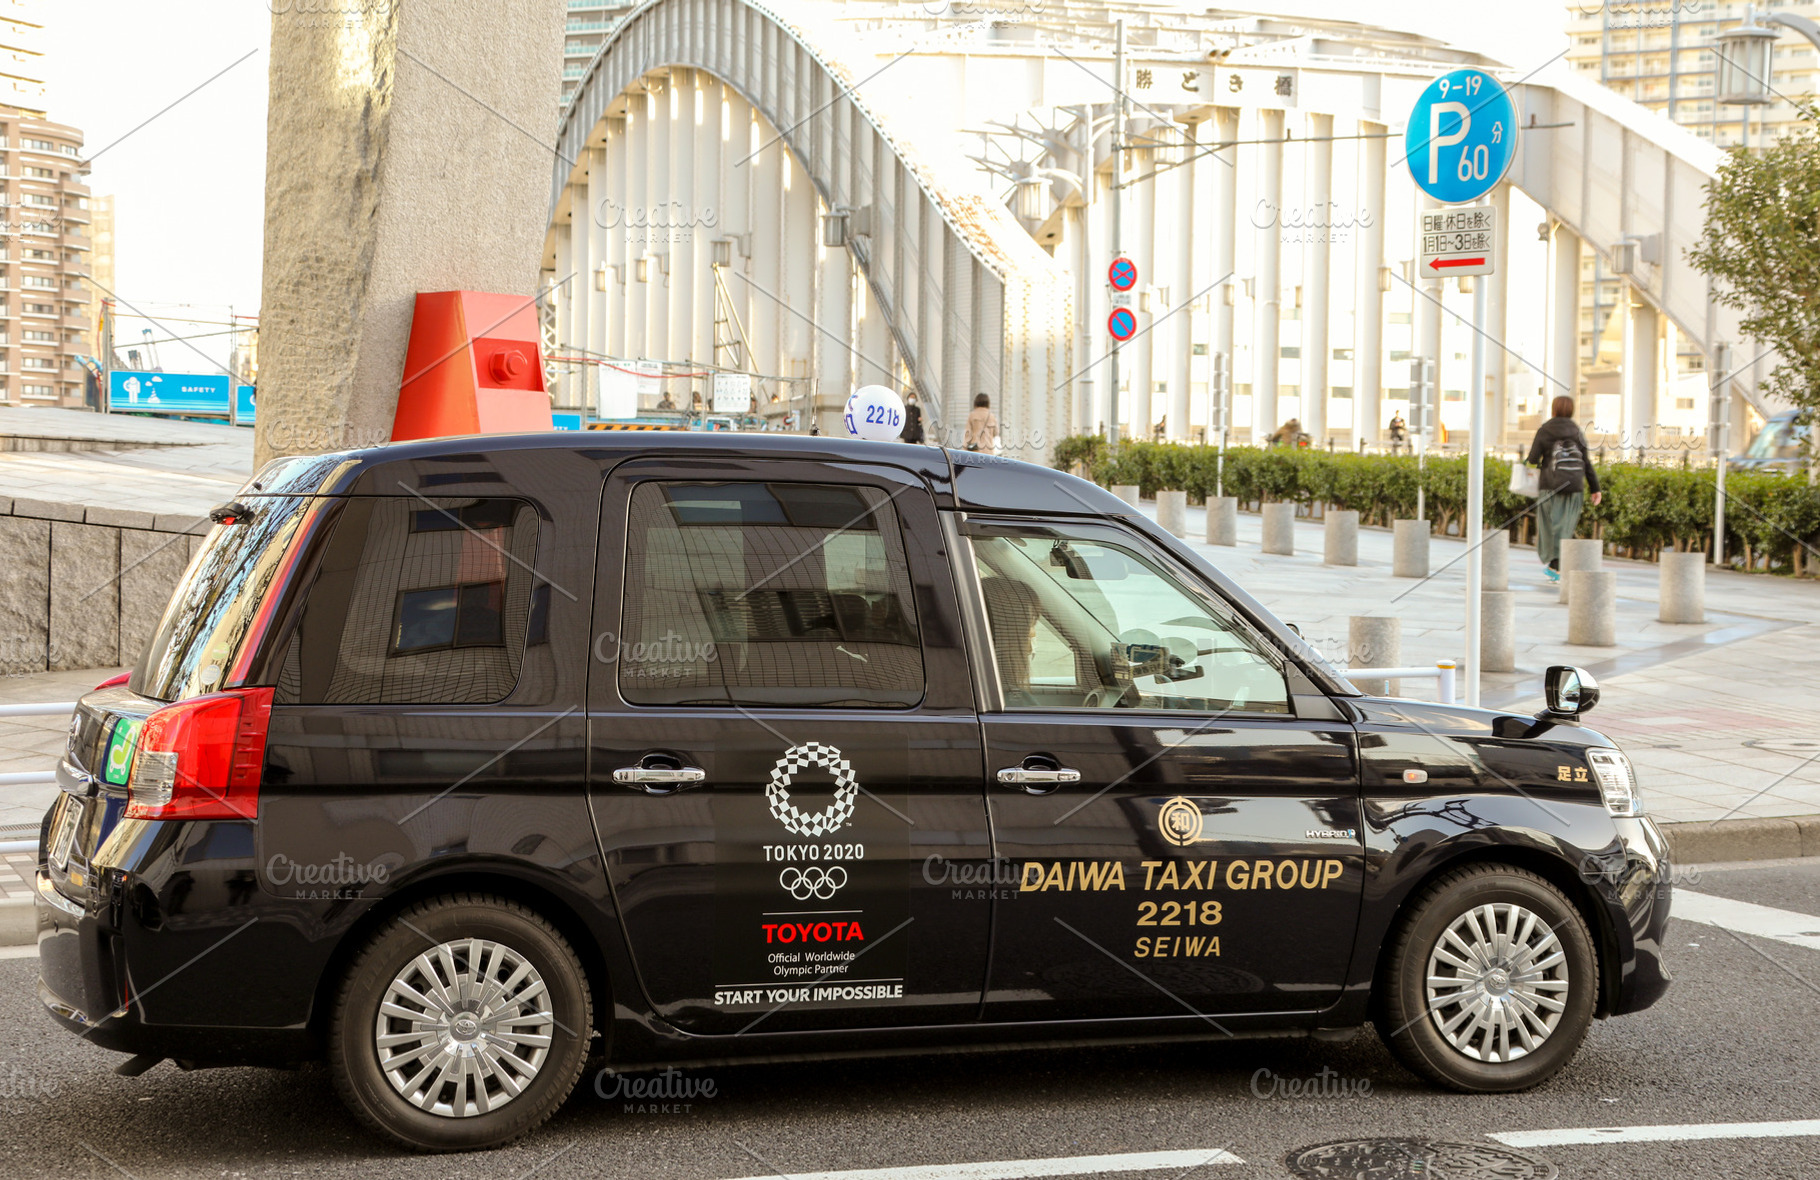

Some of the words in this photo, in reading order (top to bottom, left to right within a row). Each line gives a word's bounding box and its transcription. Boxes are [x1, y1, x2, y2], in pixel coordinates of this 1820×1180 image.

[1136, 69, 1293, 97] 勝どき橋
[1438, 75, 1483, 99] 9-19
[1428, 101, 1472, 184] P
[1491, 121, 1504, 144] 分
[1457, 144, 1490, 182] 60
[865, 404, 900, 427] 2218
[1557, 765, 1589, 782] 足立
[762, 844, 820, 861] TOKYO
[823, 843, 865, 860] 2020
[1019, 861, 1126, 891] DAIWA
[1140, 860, 1218, 891] TAXI
[1225, 859, 1344, 890] GROUP
[1136, 901, 1223, 926] 2218
[762, 921, 864, 944] TOYOTA
[768, 952, 800, 963] Official
[804, 950, 856, 962] Worldwide
[1133, 936, 1221, 958] SEIWA
[773, 965, 813, 977] Olympic
[814, 964, 849, 975] Partner
[714, 989, 763, 1005] START
[766, 988, 810, 1003] YOUR
[813, 984, 904, 1001] IMPOSSIBLE
